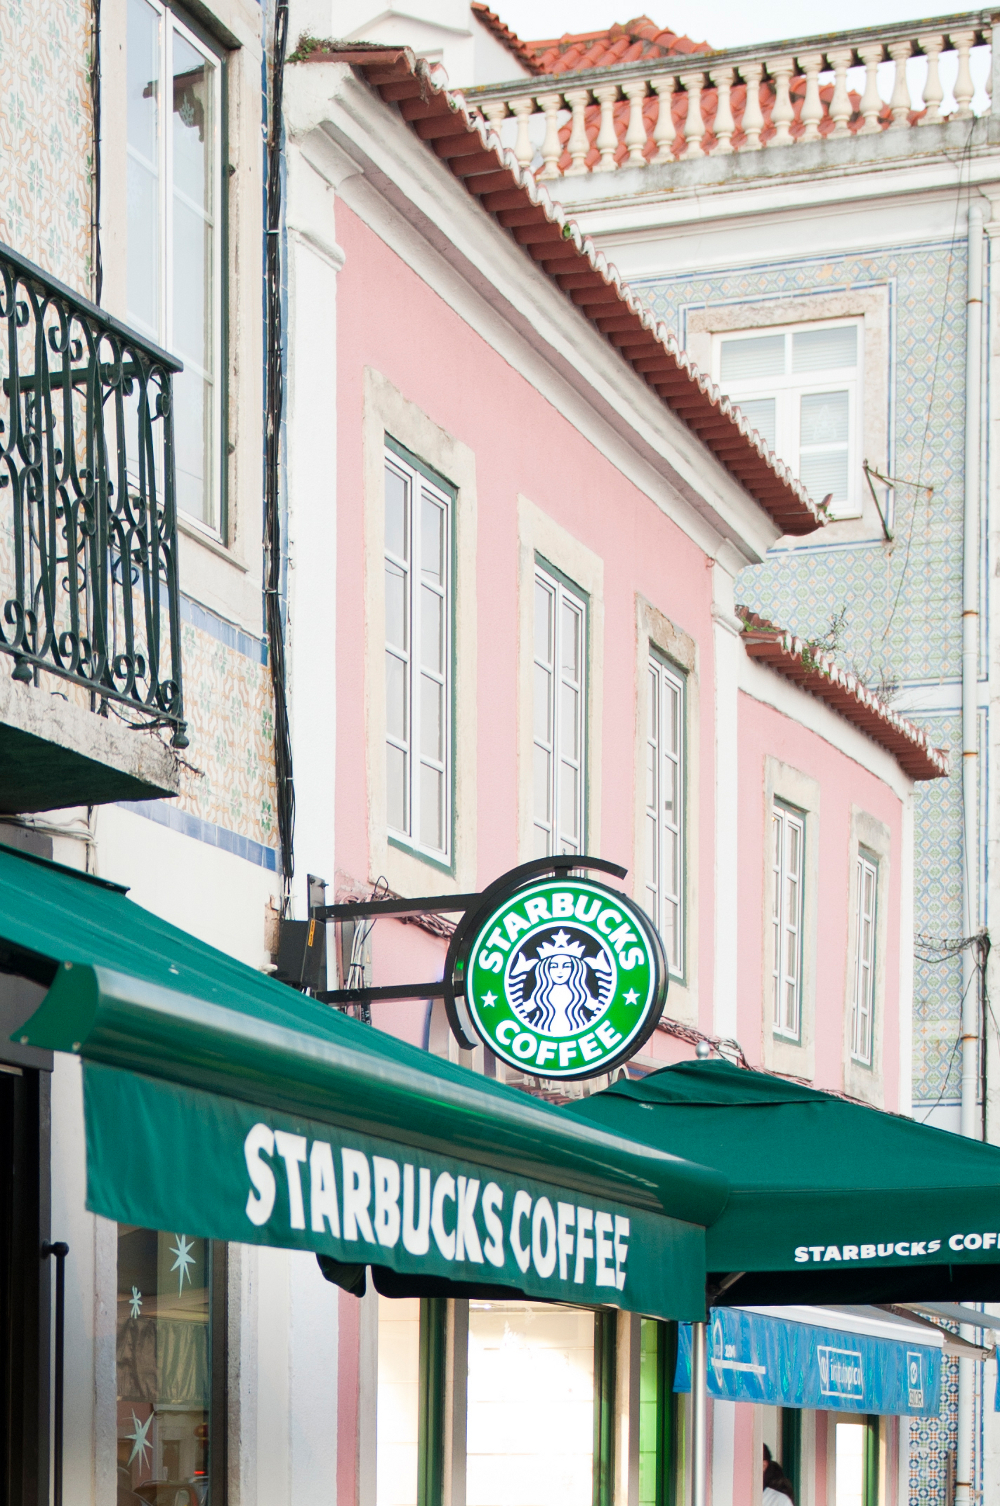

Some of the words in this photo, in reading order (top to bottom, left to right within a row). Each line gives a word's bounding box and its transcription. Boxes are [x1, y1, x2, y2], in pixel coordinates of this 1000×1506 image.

[478, 892, 645, 974] STARBUCKS
[494, 1019, 623, 1067] COFFEE
[244, 1122, 504, 1267] STARBUCKS
[509, 1190, 630, 1291] COFFEE
[794, 1239, 941, 1262] STARBUCKS
[948, 1232, 1000, 1251] COF
